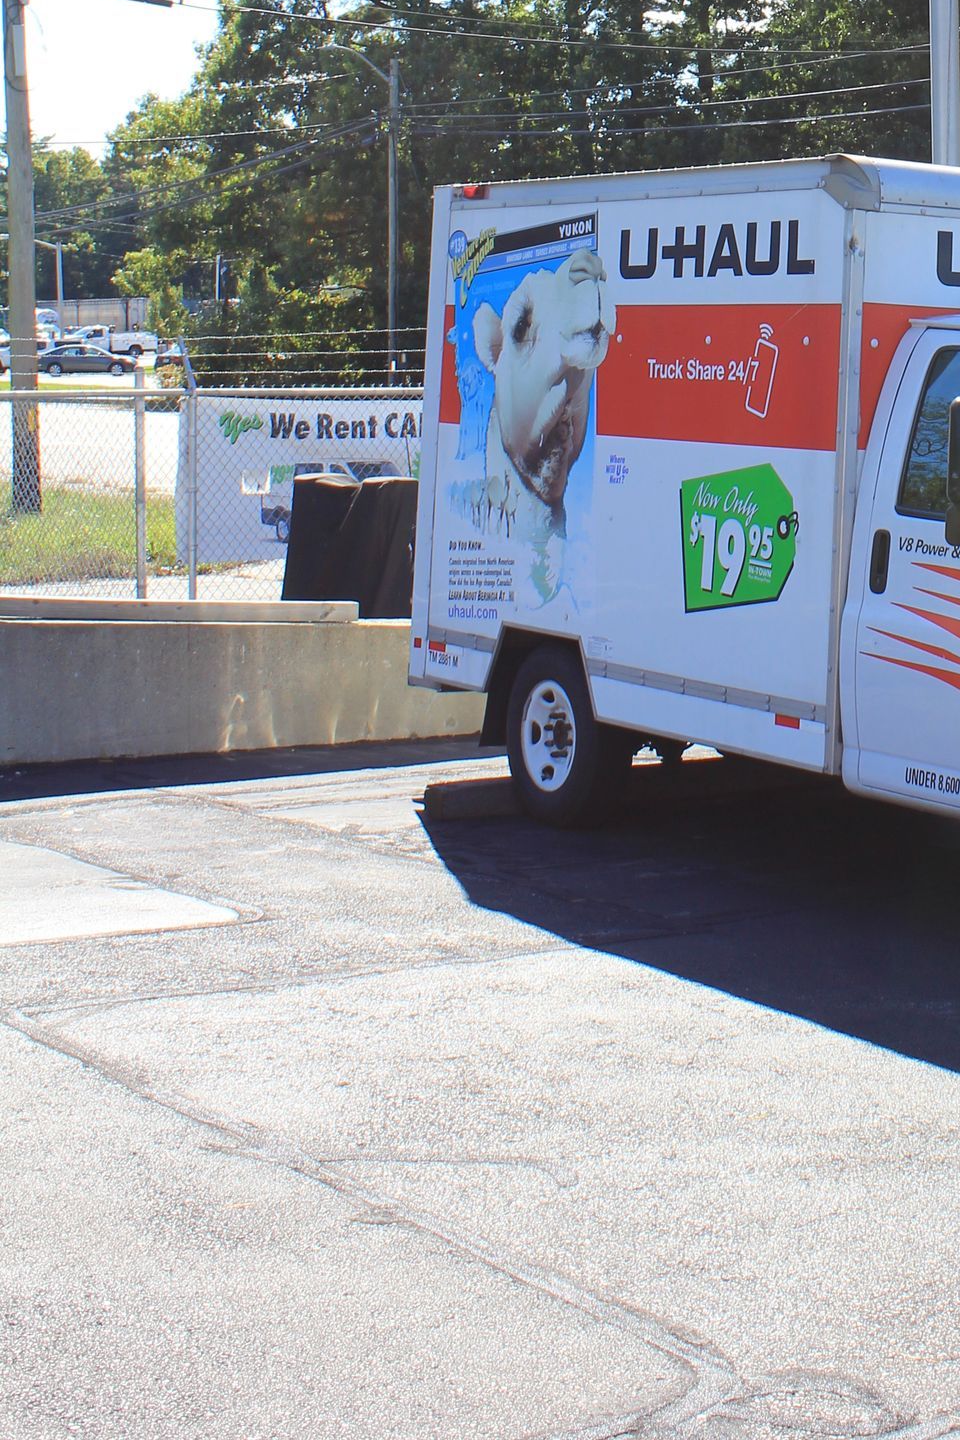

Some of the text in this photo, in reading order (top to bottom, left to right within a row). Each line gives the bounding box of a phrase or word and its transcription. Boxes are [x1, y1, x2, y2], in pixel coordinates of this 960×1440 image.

[559, 219, 592, 238] YUKON
[647, 356, 760, 385] Truck Share 24/7
[270, 412, 310, 439] We
[317, 413, 378, 439] Rent
[692, 481, 759, 527] Now Only
[899, 536, 913, 552] V8
[915, 539, 950, 557] Power
[448, 605, 498, 619] uhaul.com
[429, 651, 438, 663] TM
[452, 656, 459, 667] M
[905, 766, 937, 790] UNDER
[938, 774, 960, 795] 8,600
